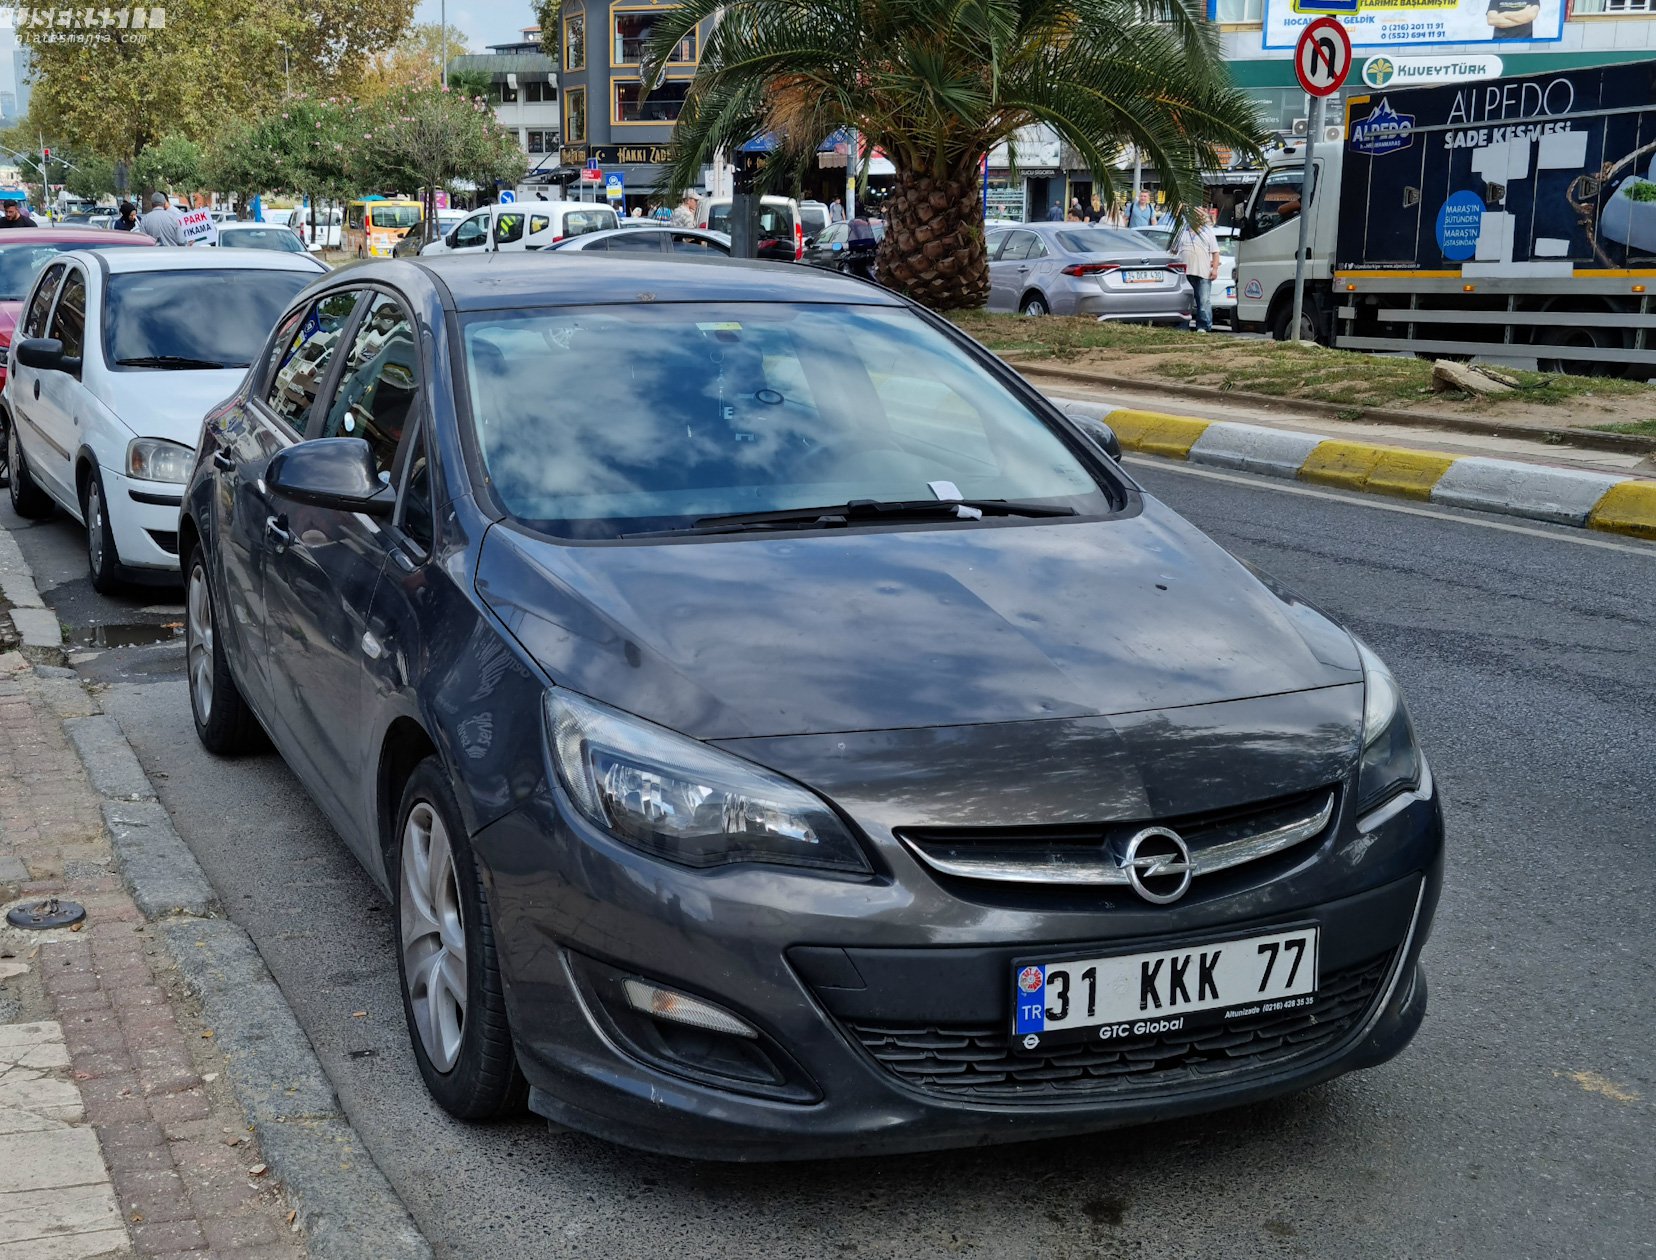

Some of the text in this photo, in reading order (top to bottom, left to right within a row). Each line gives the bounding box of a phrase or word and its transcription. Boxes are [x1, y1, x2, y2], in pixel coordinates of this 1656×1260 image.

[1344, 14, 1375, 24] GELDİK
[1352, 120, 1411, 143] ALPEDO
[1443, 129, 1489, 149] SADE
[1446, 204, 1480, 214] MARAŞ'IN
[183, 212, 208, 225] PARK
[1045, 938, 1307, 1021] 31 KKK 77
[1021, 1003, 1042, 1021] TR
[1224, 1001, 1261, 1019] Altunizade
[1099, 1017, 1184, 1039] GTC Global
